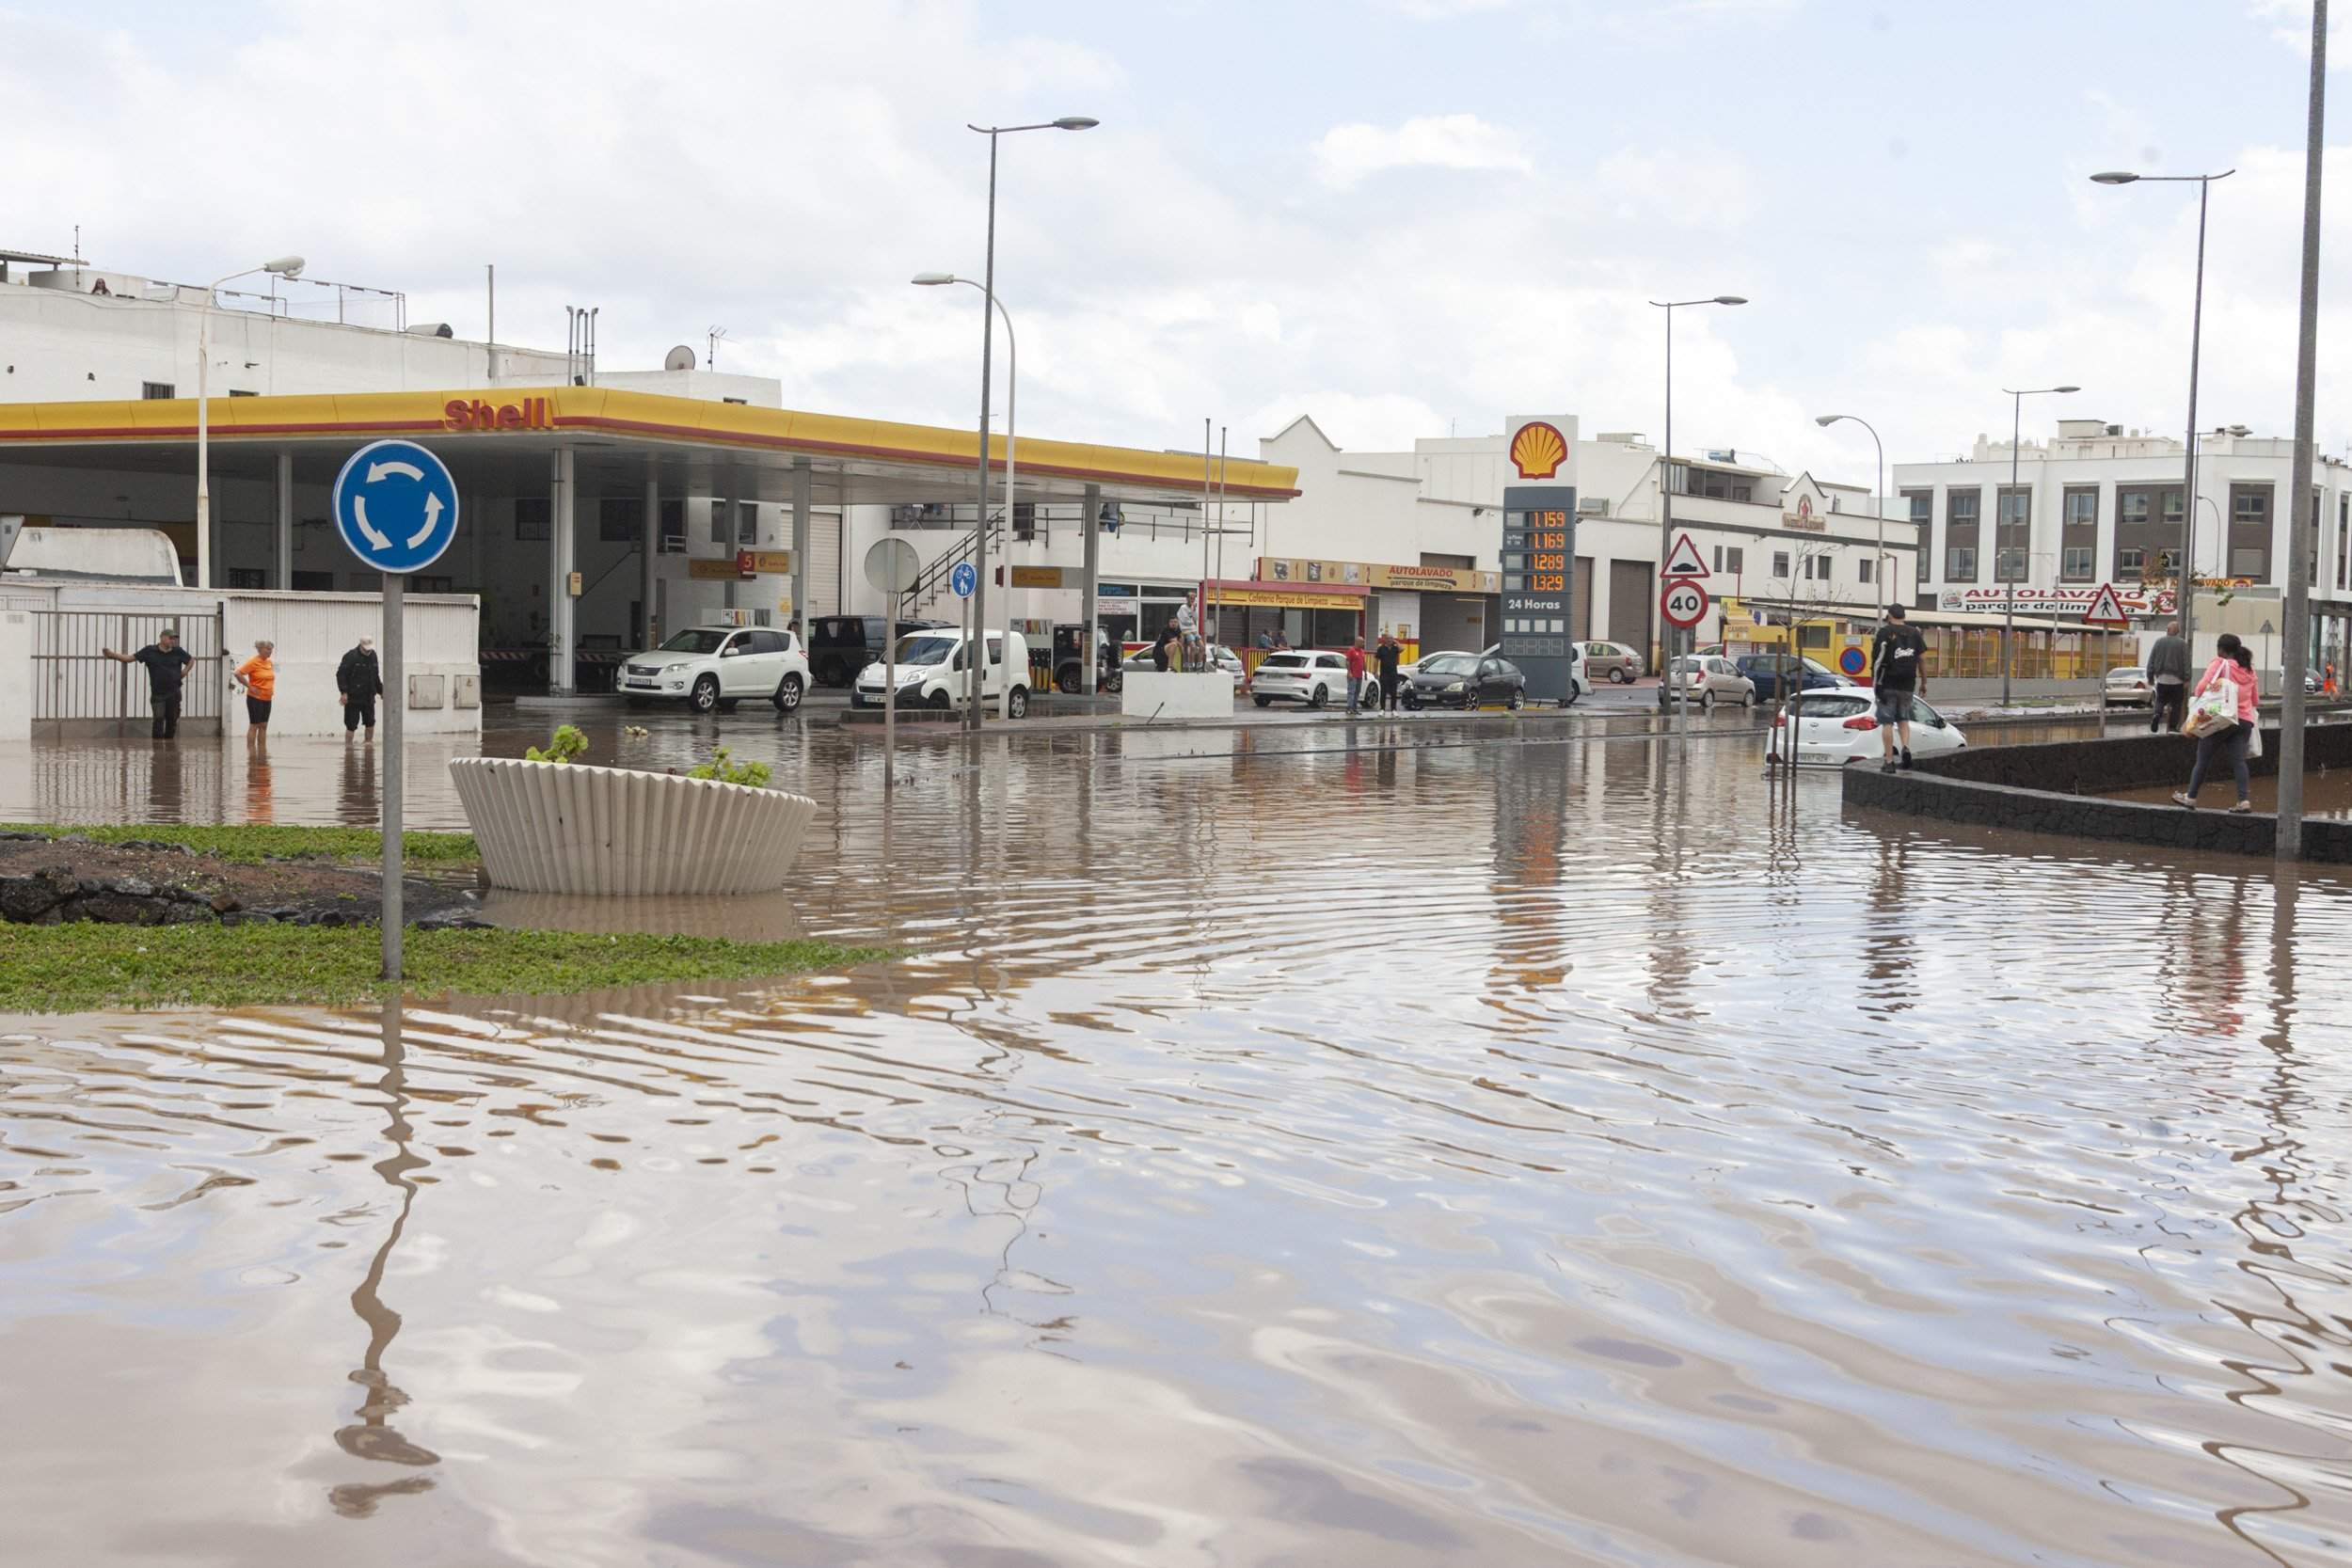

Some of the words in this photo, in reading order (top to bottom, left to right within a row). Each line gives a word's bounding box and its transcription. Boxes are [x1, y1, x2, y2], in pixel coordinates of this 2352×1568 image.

[445, 398, 545, 430] Shell
[744, 555, 752, 569] 5
[1389, 566, 1453, 577] AUTOLAVADO
[1508, 598, 1521, 610] 24
[1524, 598, 1561, 610] Horas
[1670, 595, 1698, 611] 40
